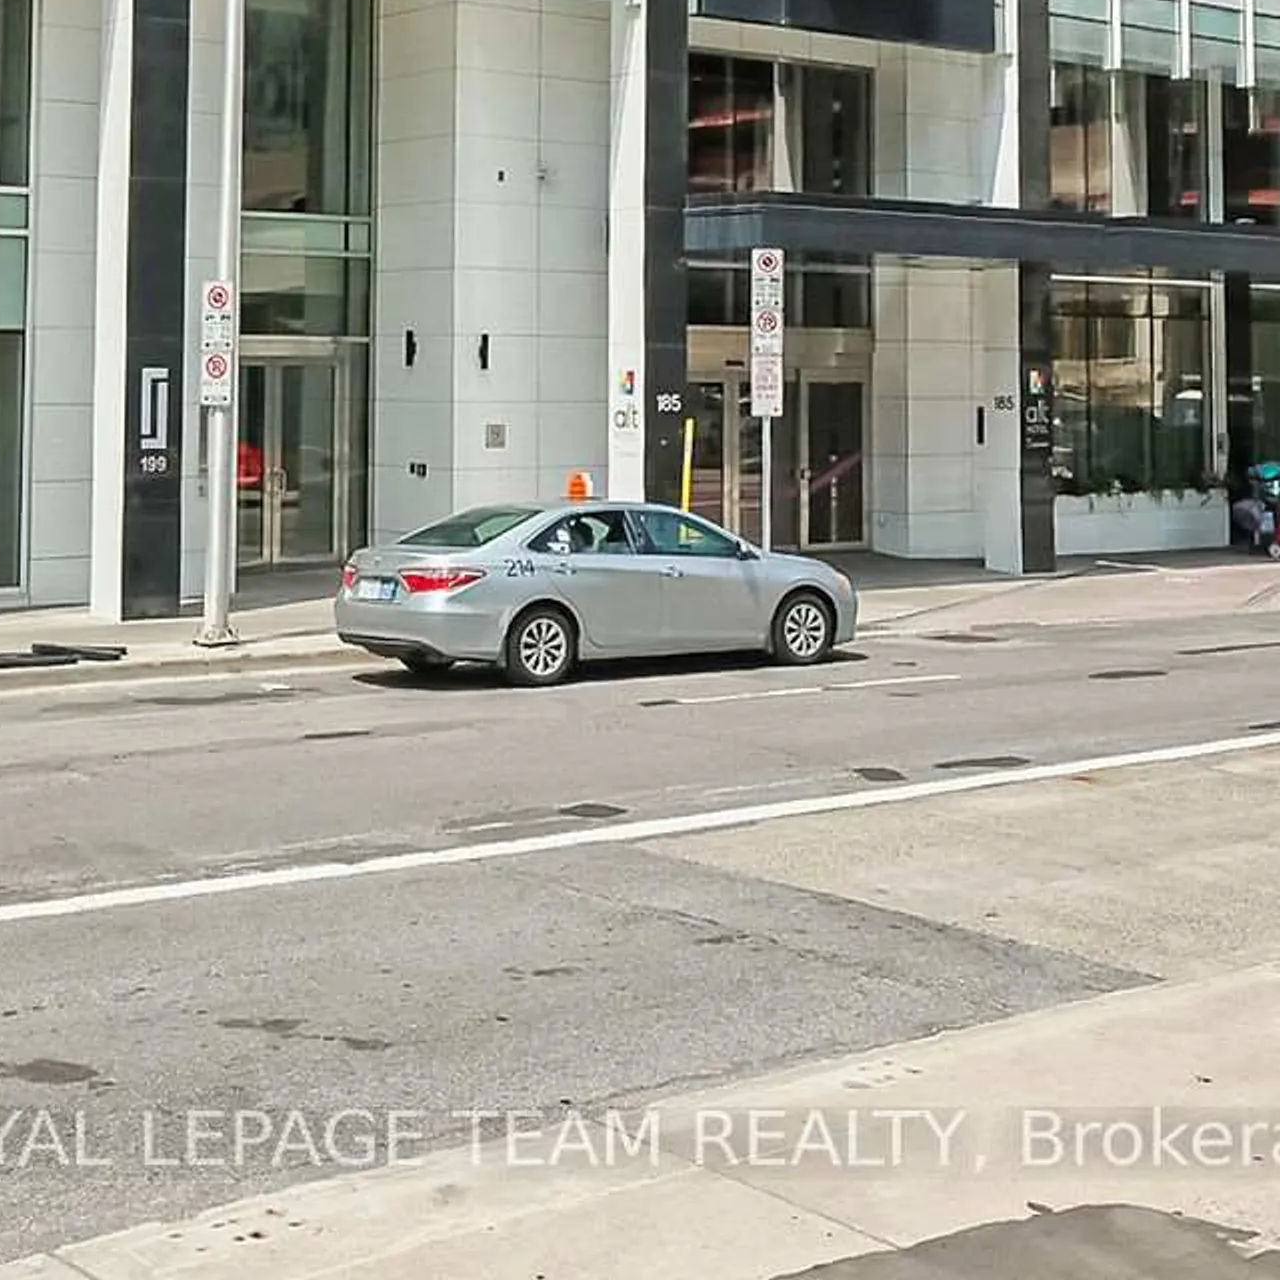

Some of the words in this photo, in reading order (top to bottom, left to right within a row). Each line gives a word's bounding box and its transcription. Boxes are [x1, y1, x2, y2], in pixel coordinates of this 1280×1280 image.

[656, 393, 682, 413] 185
[140, 455, 167, 472] 199
[505, 559, 536, 578] 214
